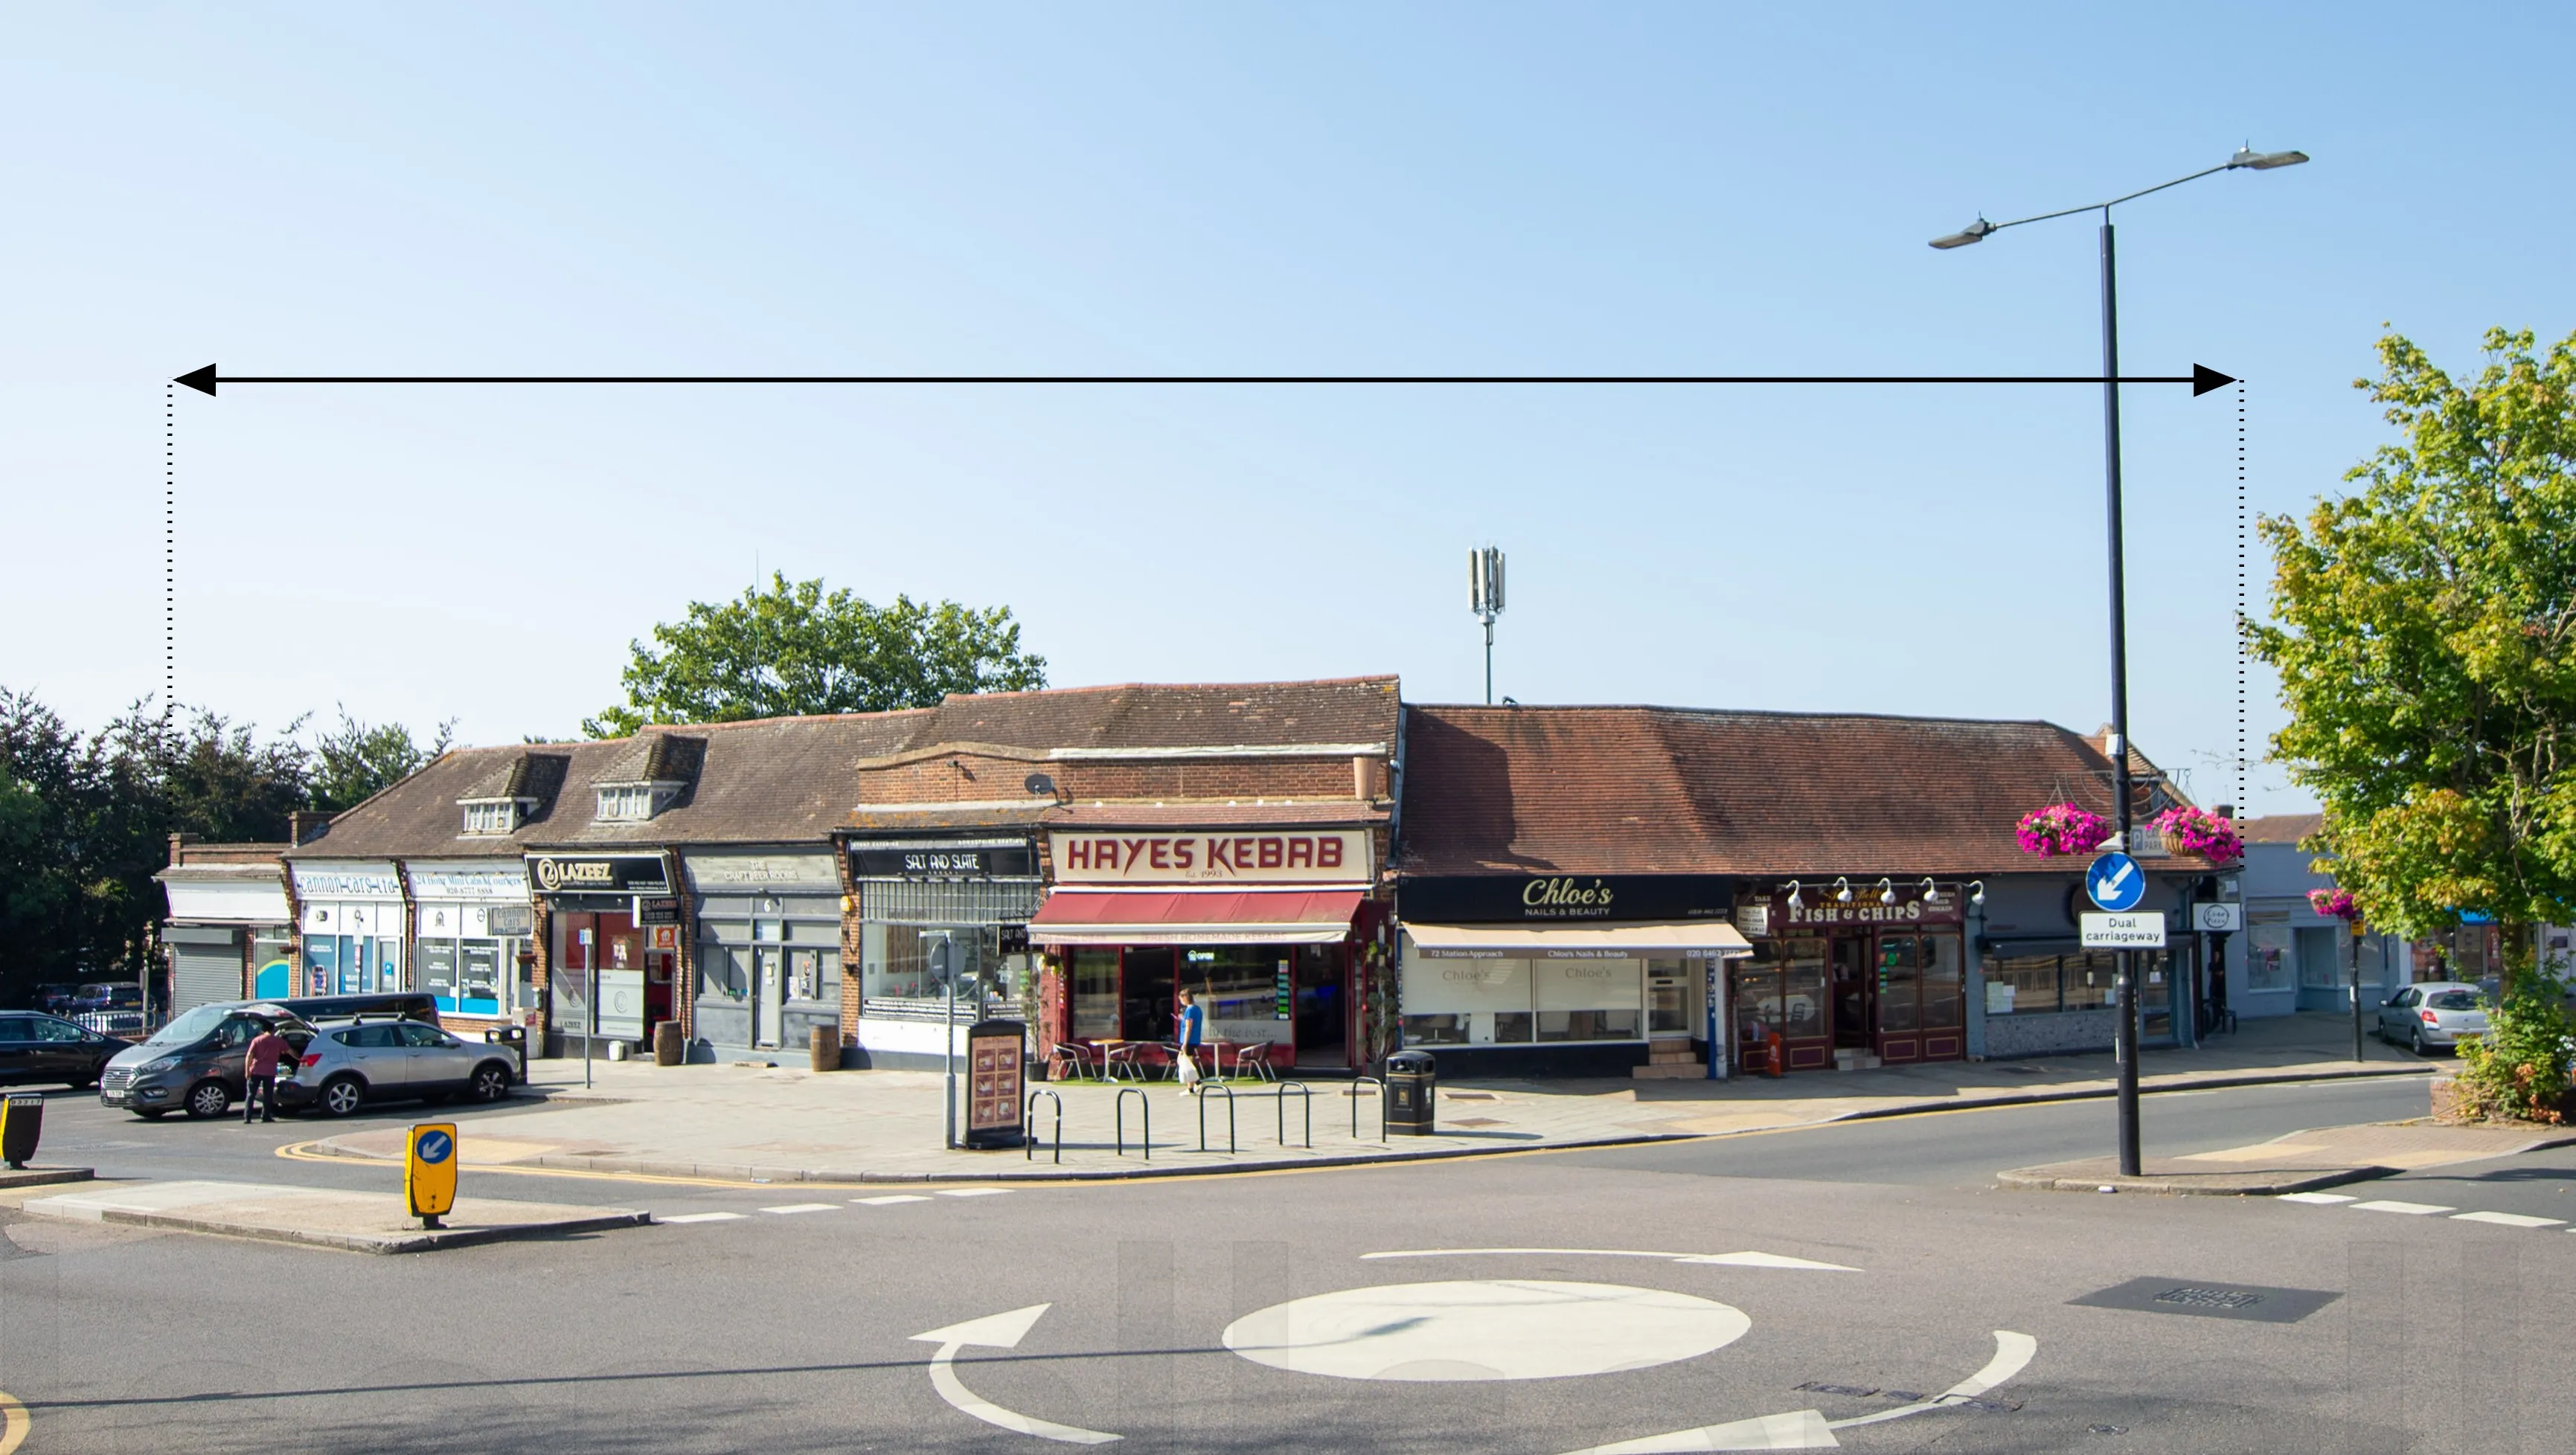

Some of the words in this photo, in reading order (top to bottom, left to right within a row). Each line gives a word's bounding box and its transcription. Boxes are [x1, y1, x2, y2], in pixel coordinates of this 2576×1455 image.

[905, 854, 926, 870] SALT
[929, 854, 949, 870] AND
[952, 854, 980, 870] SLATE
[1068, 838, 1196, 876] HAYES
[1207, 837, 1343, 876] KEBAB
[558, 862, 613, 881] LAZEEZ
[1201, 870, 1223, 879] 1993
[1522, 878, 1614, 905] Chloe's
[763, 899, 771, 913] 6
[1788, 902, 1839, 922] FISH
[1842, 909, 1853, 920] &
[1858, 900, 1920, 920] CHIPS
[1569, 908, 1611, 916] BEAUTY
[2109, 917, 2136, 928] Dual
[1000, 929, 1013, 940] SALT
[1180, 933, 1240, 942] HOMEMADE
[2086, 931, 2160, 942] carriageway
[1431, 949, 1440, 957] 72
[1441, 949, 1467, 957] Station
[1467, 949, 1504, 960] Approach
[1548, 949, 1574, 958] Chloe's
[1576, 949, 1595, 958] Nails
[1603, 949, 1628, 960] Beauty
[1686, 949, 1702, 957] 020
[1702, 949, 1722, 957] 8462
[1442, 969, 1490, 981] Chloe's
[1564, 966, 1612, 979] Chloe's
